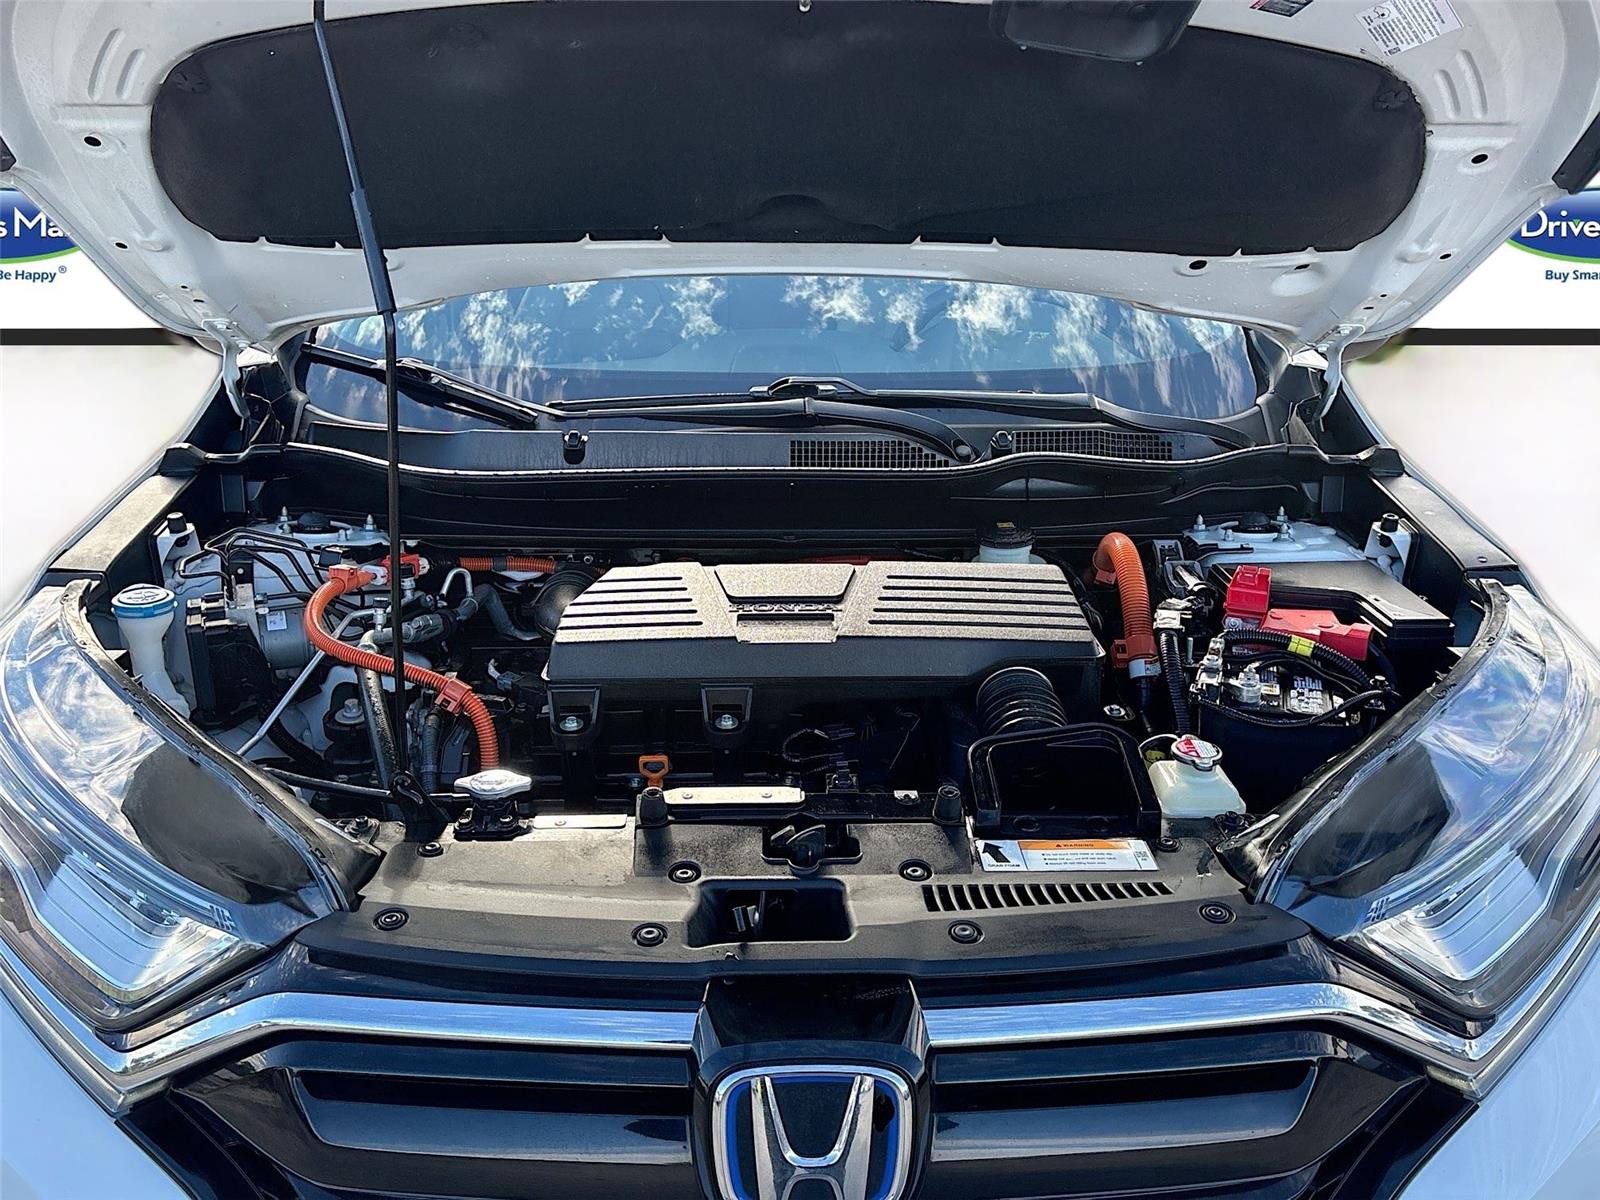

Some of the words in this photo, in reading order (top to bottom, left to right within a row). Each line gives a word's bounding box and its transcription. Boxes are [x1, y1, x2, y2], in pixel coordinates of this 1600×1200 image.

[14, 207, 69, 237] Ma
[1521, 210, 1600, 237] Drive
[15, 270, 56, 283] Happy
[1545, 270, 1570, 283] Buy
[1572, 270, 1600, 280] Sma
[729, 603, 842, 613] HONDA
